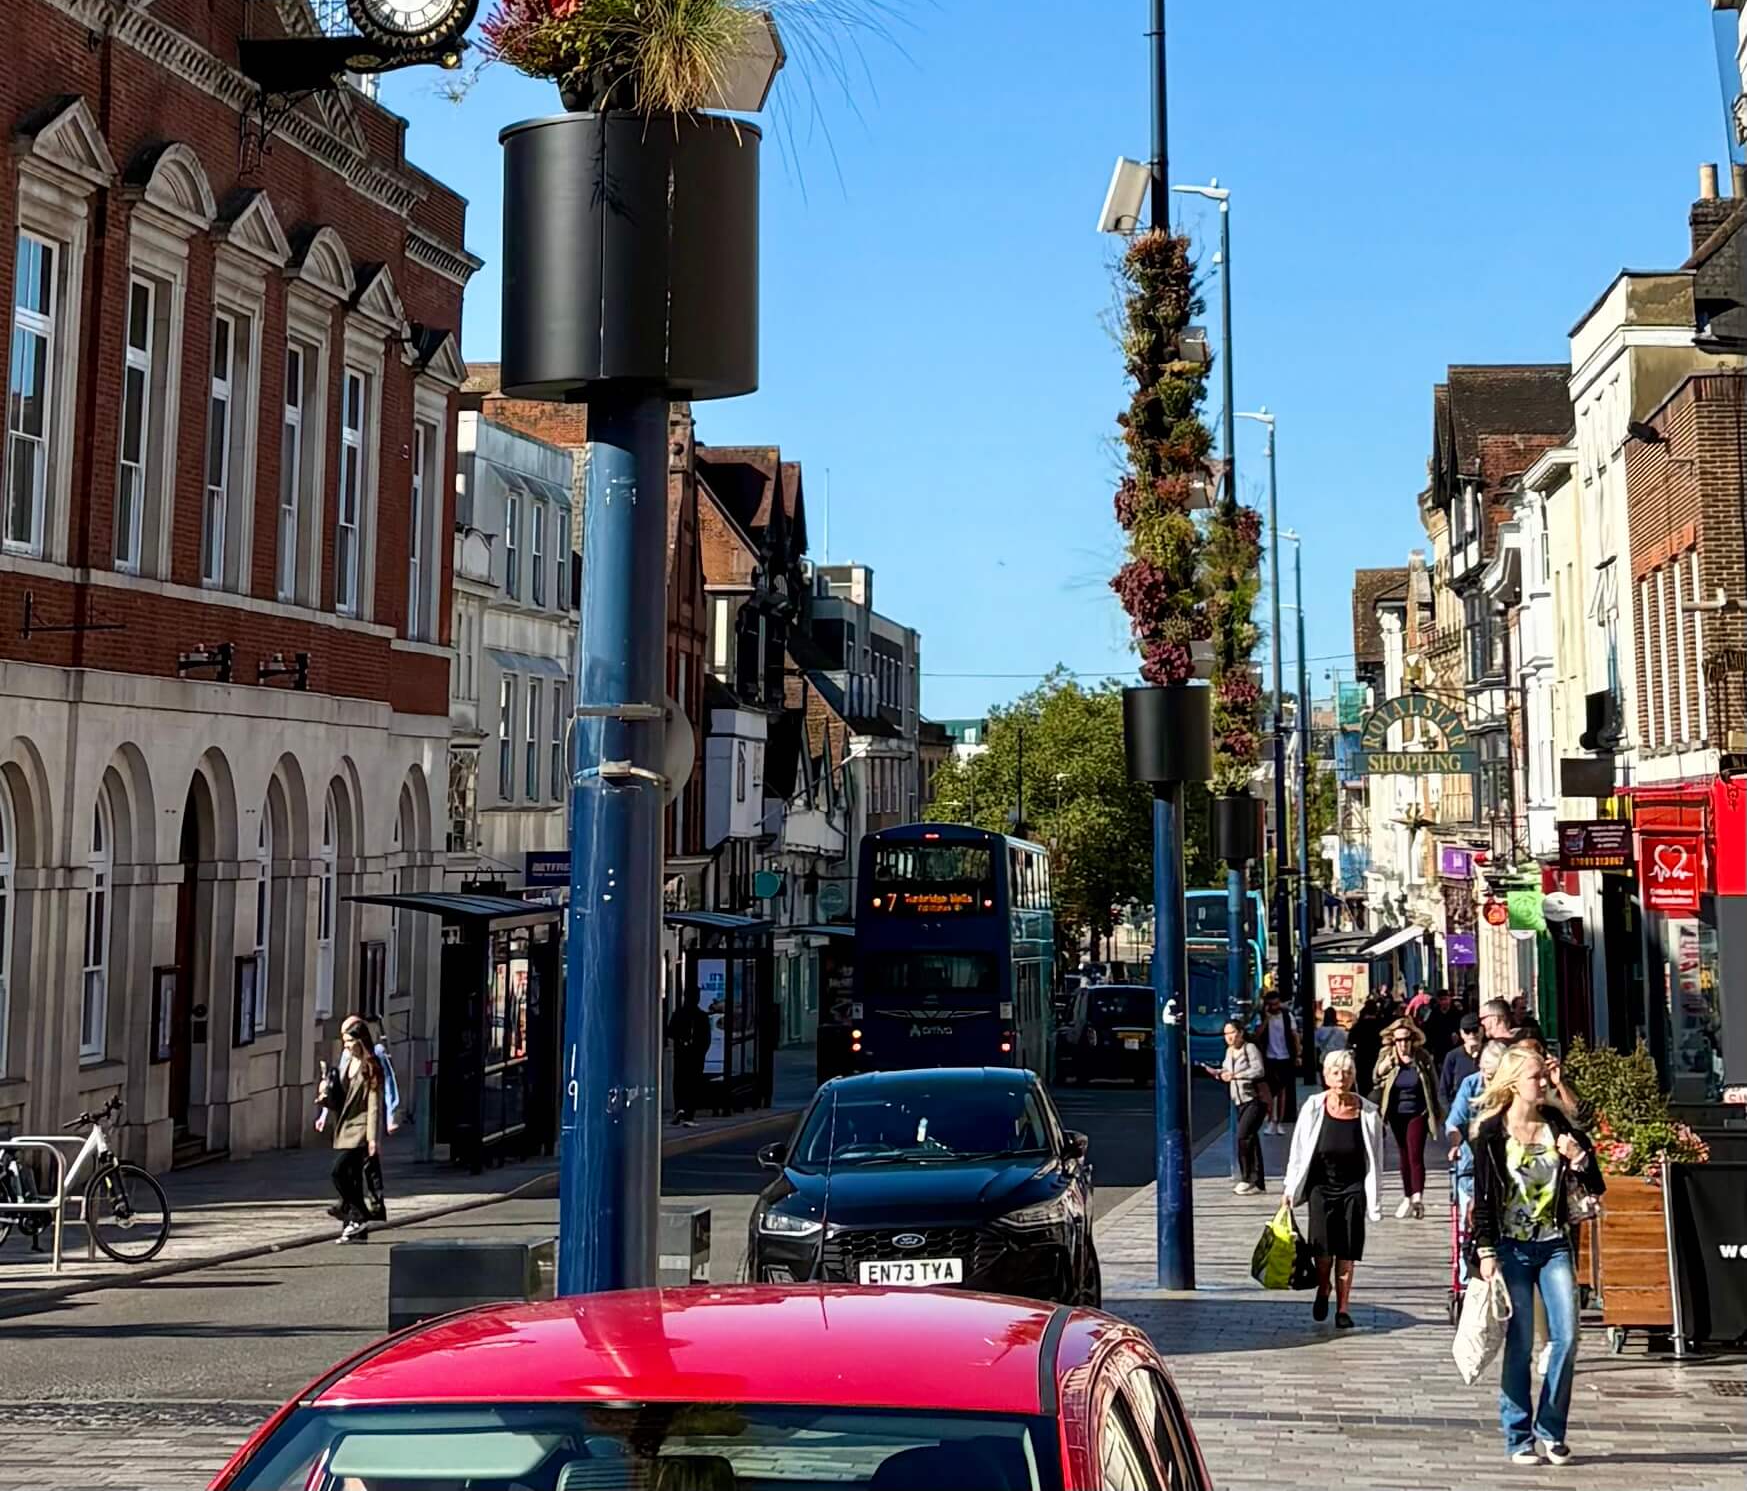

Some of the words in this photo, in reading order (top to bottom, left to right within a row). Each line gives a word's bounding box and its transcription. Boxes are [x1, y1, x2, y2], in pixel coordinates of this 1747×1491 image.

[1362, 696, 1419, 749] ROYAL
[1423, 698, 1467, 748] STAR
[1368, 753, 1461, 772] SHOPPING
[887, 892, 897, 912] 7
[868, 1263, 914, 1283] EN73
[920, 1262, 954, 1282] TYA
